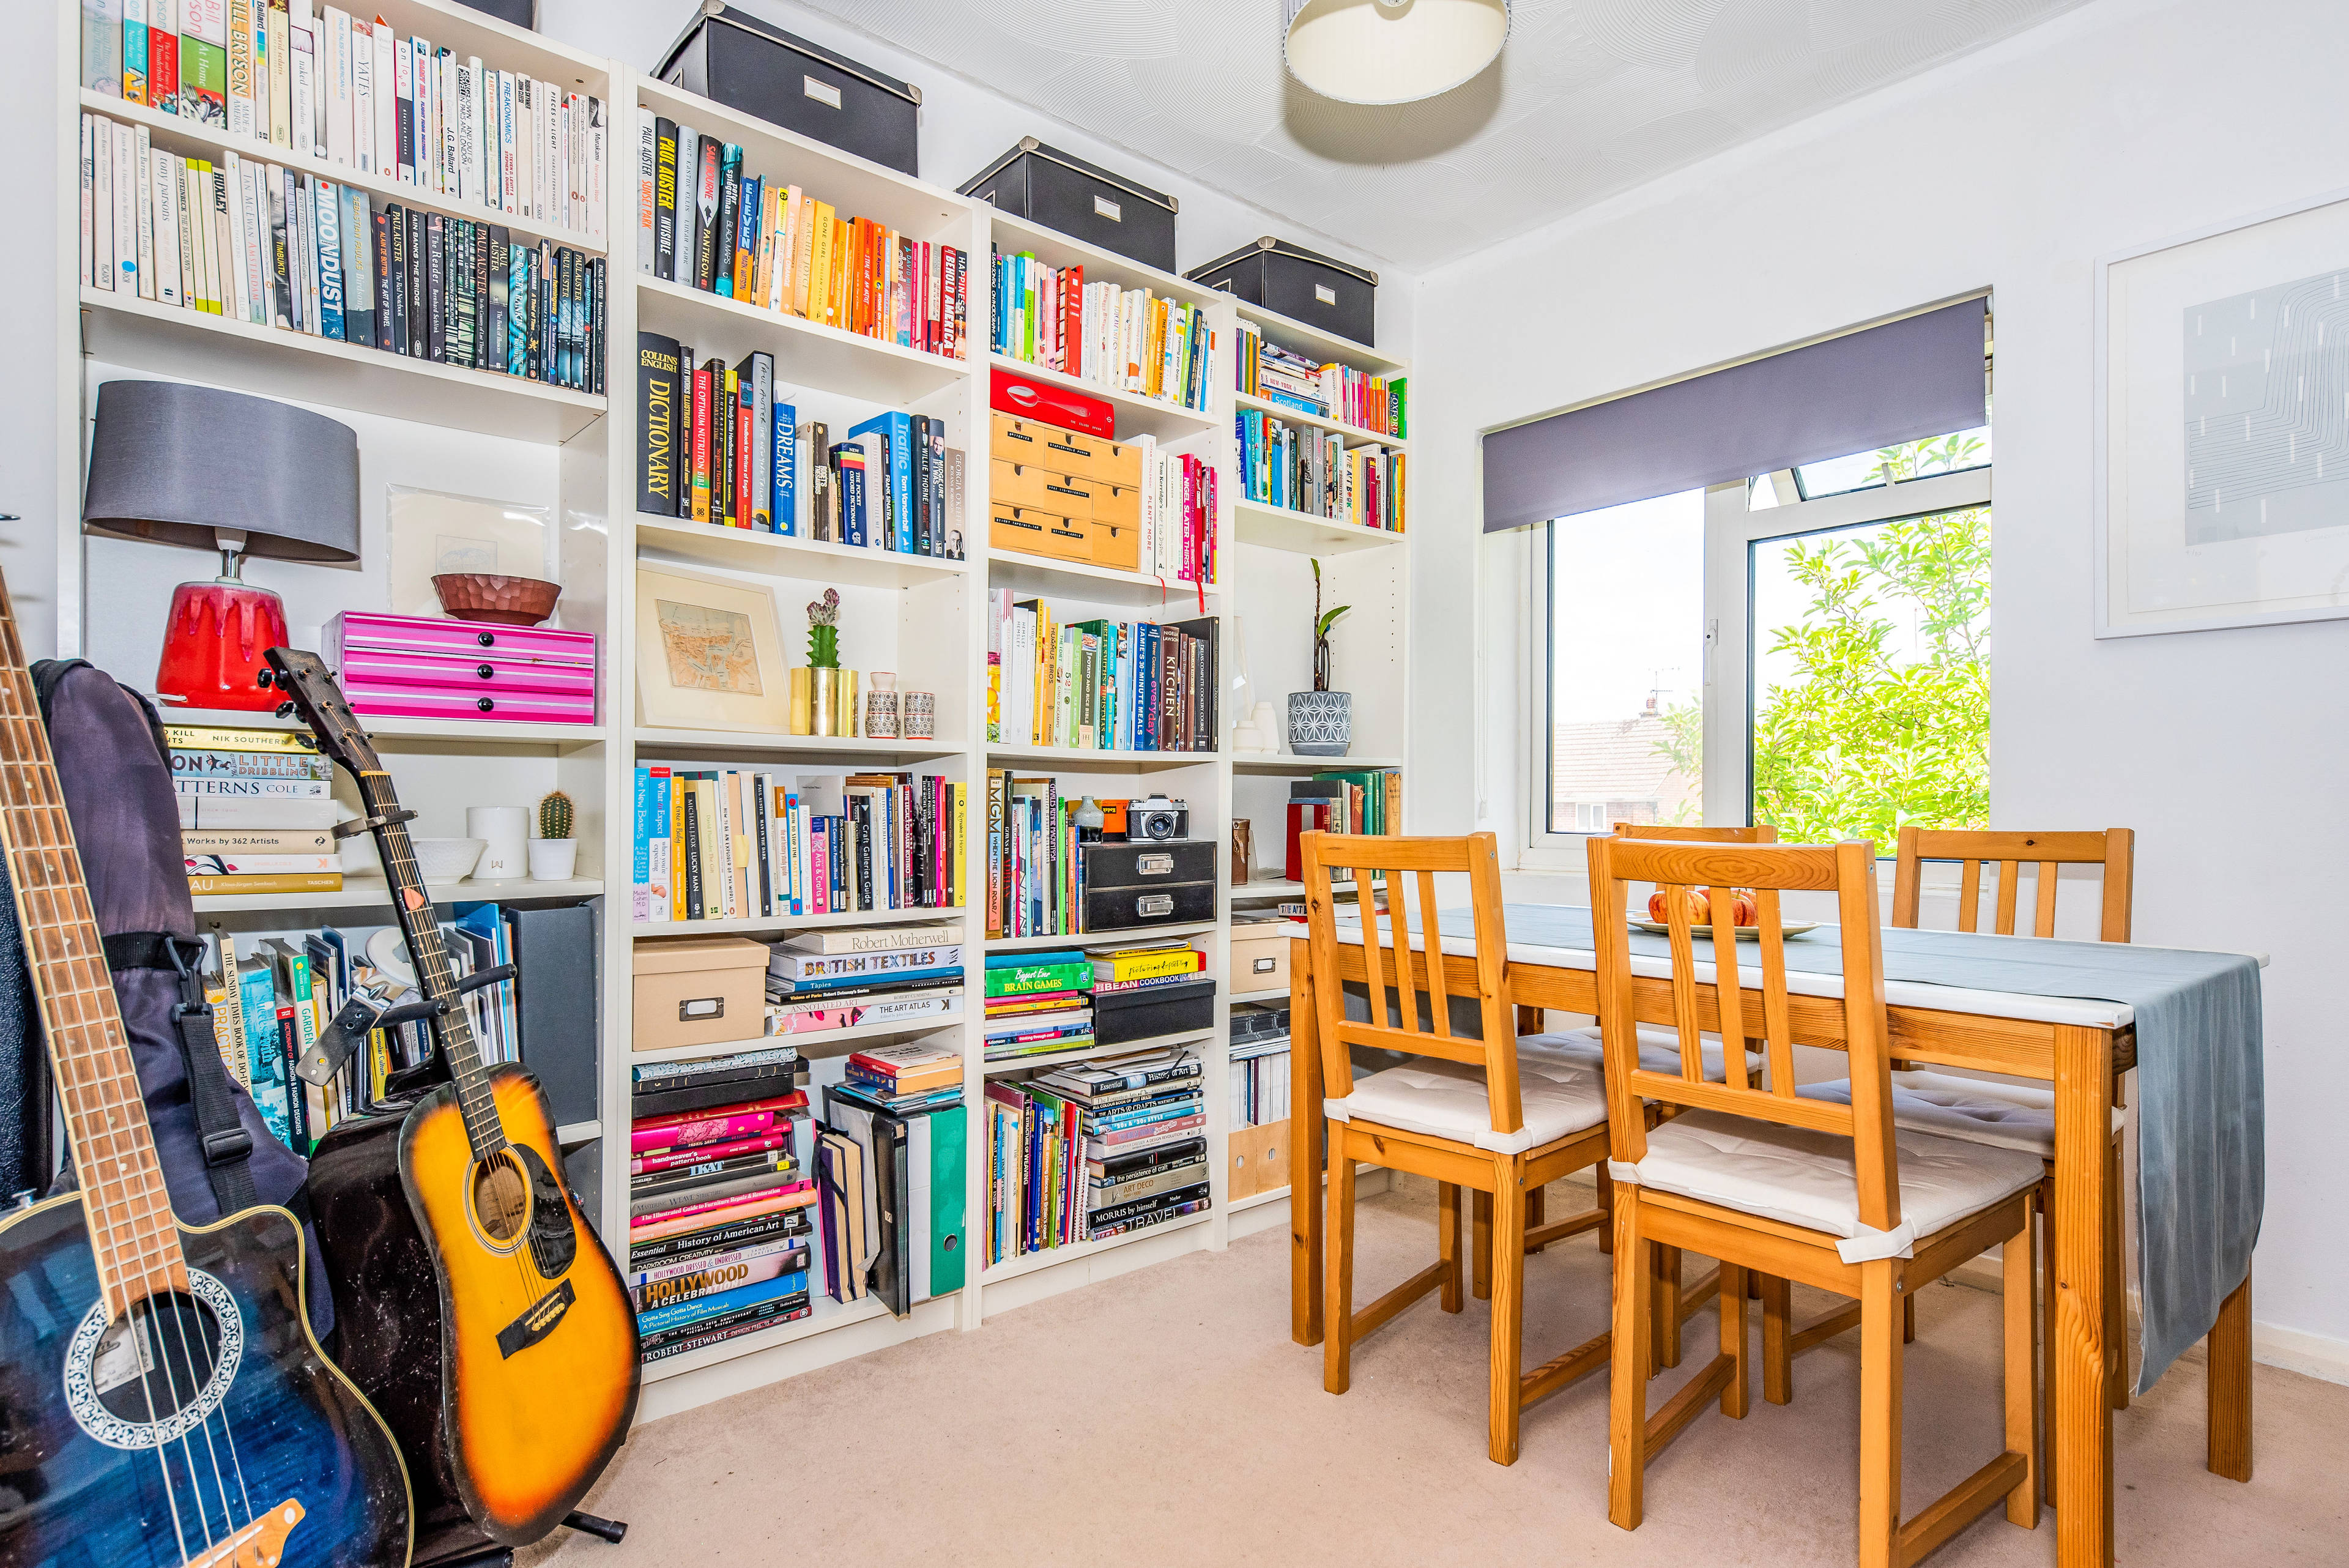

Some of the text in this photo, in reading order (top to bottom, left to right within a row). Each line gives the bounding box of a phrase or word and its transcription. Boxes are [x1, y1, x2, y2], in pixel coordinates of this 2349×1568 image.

[199, 59, 209, 86] Home
[232, 29, 248, 95] BRYSON
[358, 61, 369, 98] YATES
[642, 127, 652, 229] PAUL AUSTER SUNSET PARK
[704, 144, 715, 201] SAM BOURNE
[158, 158, 171, 221] tony parsons
[213, 172, 227, 215] HUXLEY
[659, 136, 675, 255] PAUL AUSTER INVISIBLE
[741, 182, 753, 249] ELEVEN
[317, 188, 343, 315] MOONDUST
[478, 228, 488, 294] PAUL AUSTER
[700, 228, 711, 278] PANTHEON
[944, 256, 955, 349] BEHOLD AMERICA
[641, 359, 677, 373] ENGLISH
[642, 350, 677, 365] COLLINS
[1275, 396, 1302, 410] Scotland
[648, 378, 670, 499] DICTIONARY
[897, 423, 908, 470] Traffic
[776, 422, 793, 489] DREAMS
[1165, 656, 1174, 716] KITCHEN
[239, 755, 308, 767] LITTLE
[239, 767, 308, 776] DRIBBLING
[174, 781, 259, 794] TTERNS
[637, 775, 646, 787] The
[656, 811, 666, 833] Expect
[989, 787, 1001, 833] MGM
[637, 811, 647, 839] Basics
[853, 931, 949, 949] Robert Motherwell
[224, 952, 234, 968] THE
[806, 952, 935, 976] BRITISH TEXTILES
[227, 970, 237, 999] SUNDAY
[1015, 968, 1050, 979] Biggest Ever
[1104, 975, 1179, 991] BEAN COOKBOOK
[1004, 979, 1062, 993] BRAIN GAMES
[231, 1001, 241, 1025] TIMES
[908, 1001, 930, 1010] ATLAS
[234, 1028, 243, 1049] BOOK
[284, 1022, 292, 1052] DICTIONARY
[237, 1051, 245, 1060] OF
[1100, 1081, 1122, 1091] Essential
[652, 1151, 697, 1164] handweaver's
[670, 1158, 695, 1167] pattern
[690, 1161, 724, 1176] IKAT
[1137, 1180, 1154, 1189] DECO
[1096, 1209, 1126, 1222] MORRIS
[1137, 1200, 1157, 1211] himself
[1126, 1208, 1179, 1230] TRAVEL
[631, 1246, 666, 1258] Essential
[678, 1237, 710, 1249] History
[724, 1225, 763, 1239] American
[766, 1221, 779, 1230] Art
[647, 1264, 749, 1302] HOLLYWOOD
[647, 1331, 727, 1361] ROBERT STEWART
